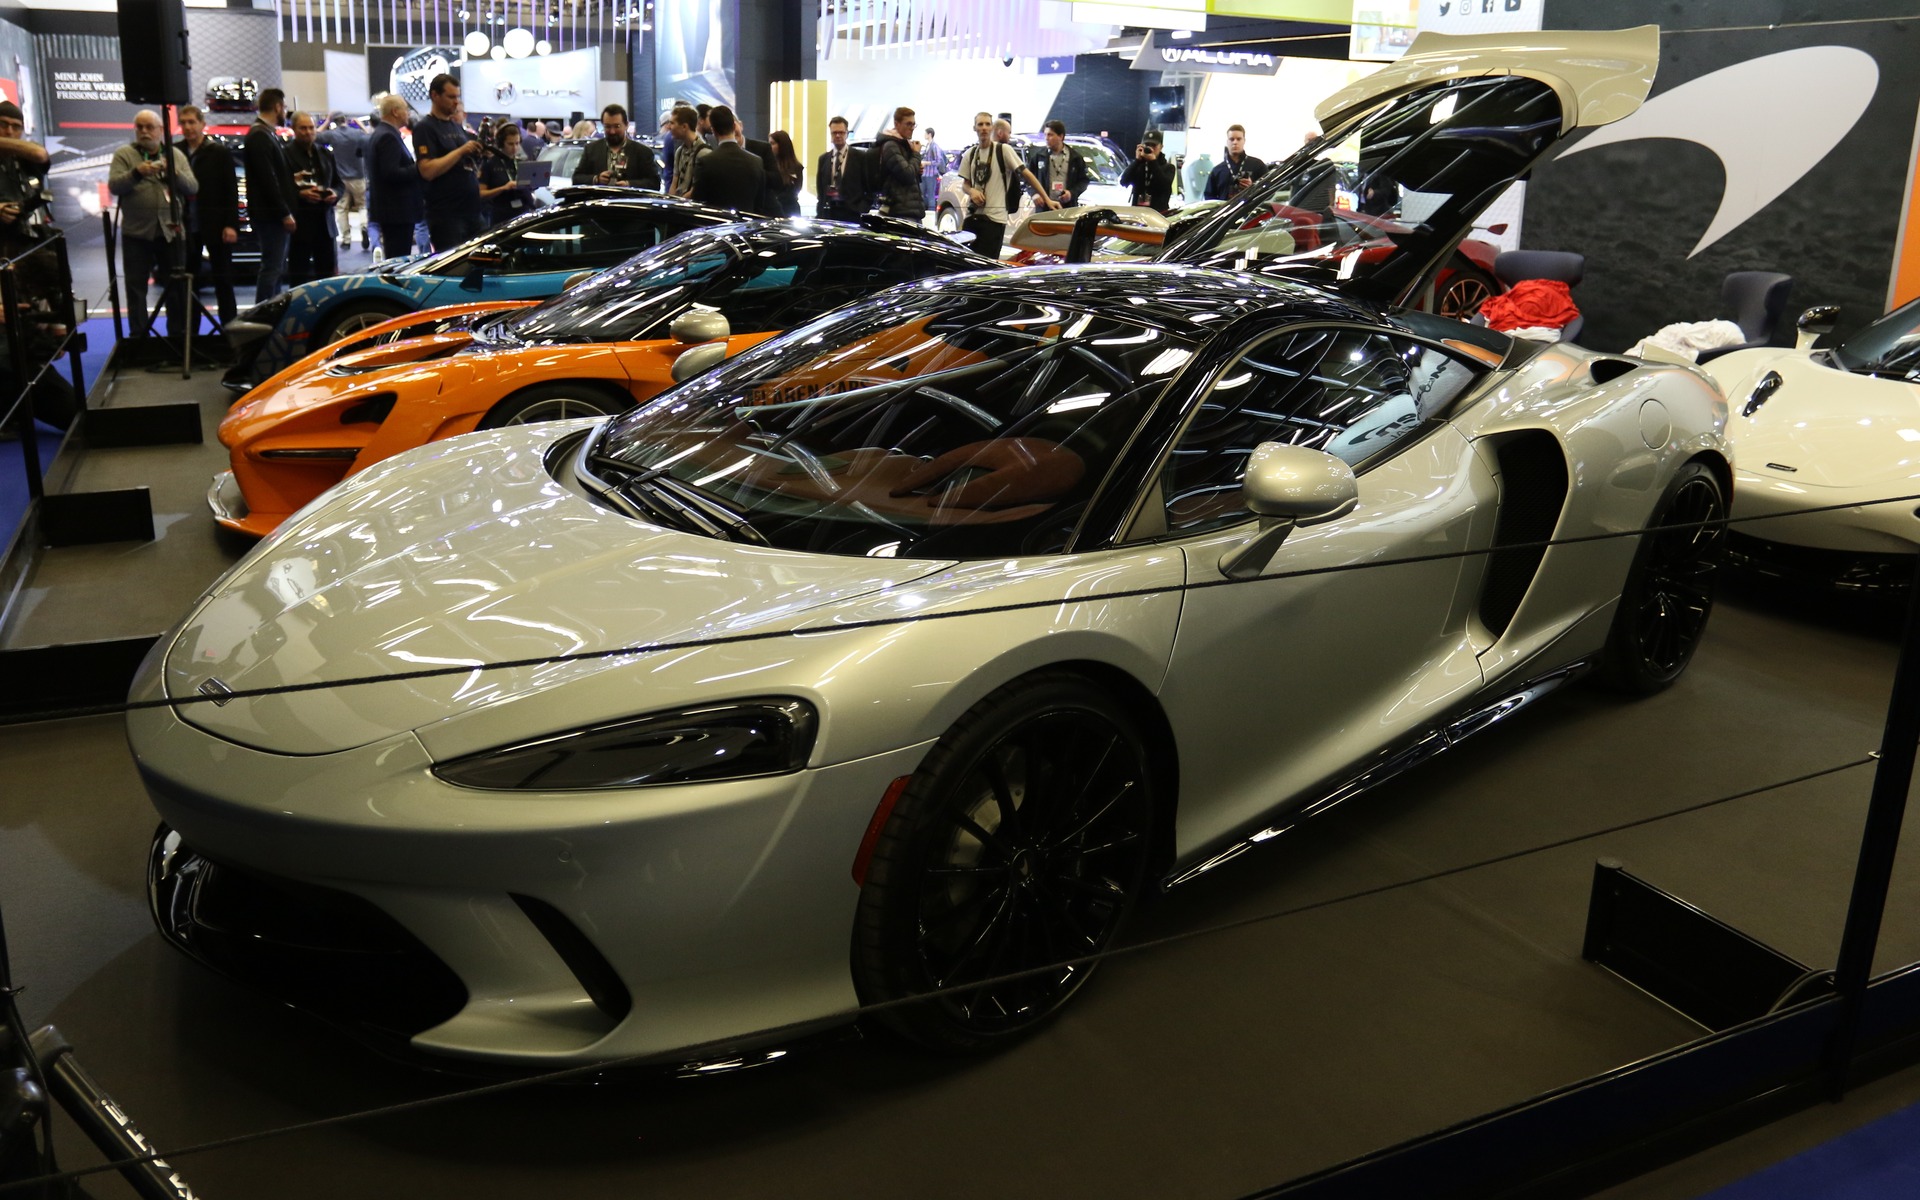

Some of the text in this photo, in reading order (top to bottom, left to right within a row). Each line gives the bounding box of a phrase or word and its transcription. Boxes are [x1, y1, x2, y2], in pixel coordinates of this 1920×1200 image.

[1181, 49, 1272, 67] ACURA
[54, 72, 104, 82] MINI JOHN
[55, 82, 126, 92] COOPER WORKS
[56, 91, 99, 100] FRISSONS
[522, 89, 582, 98] BUICK
